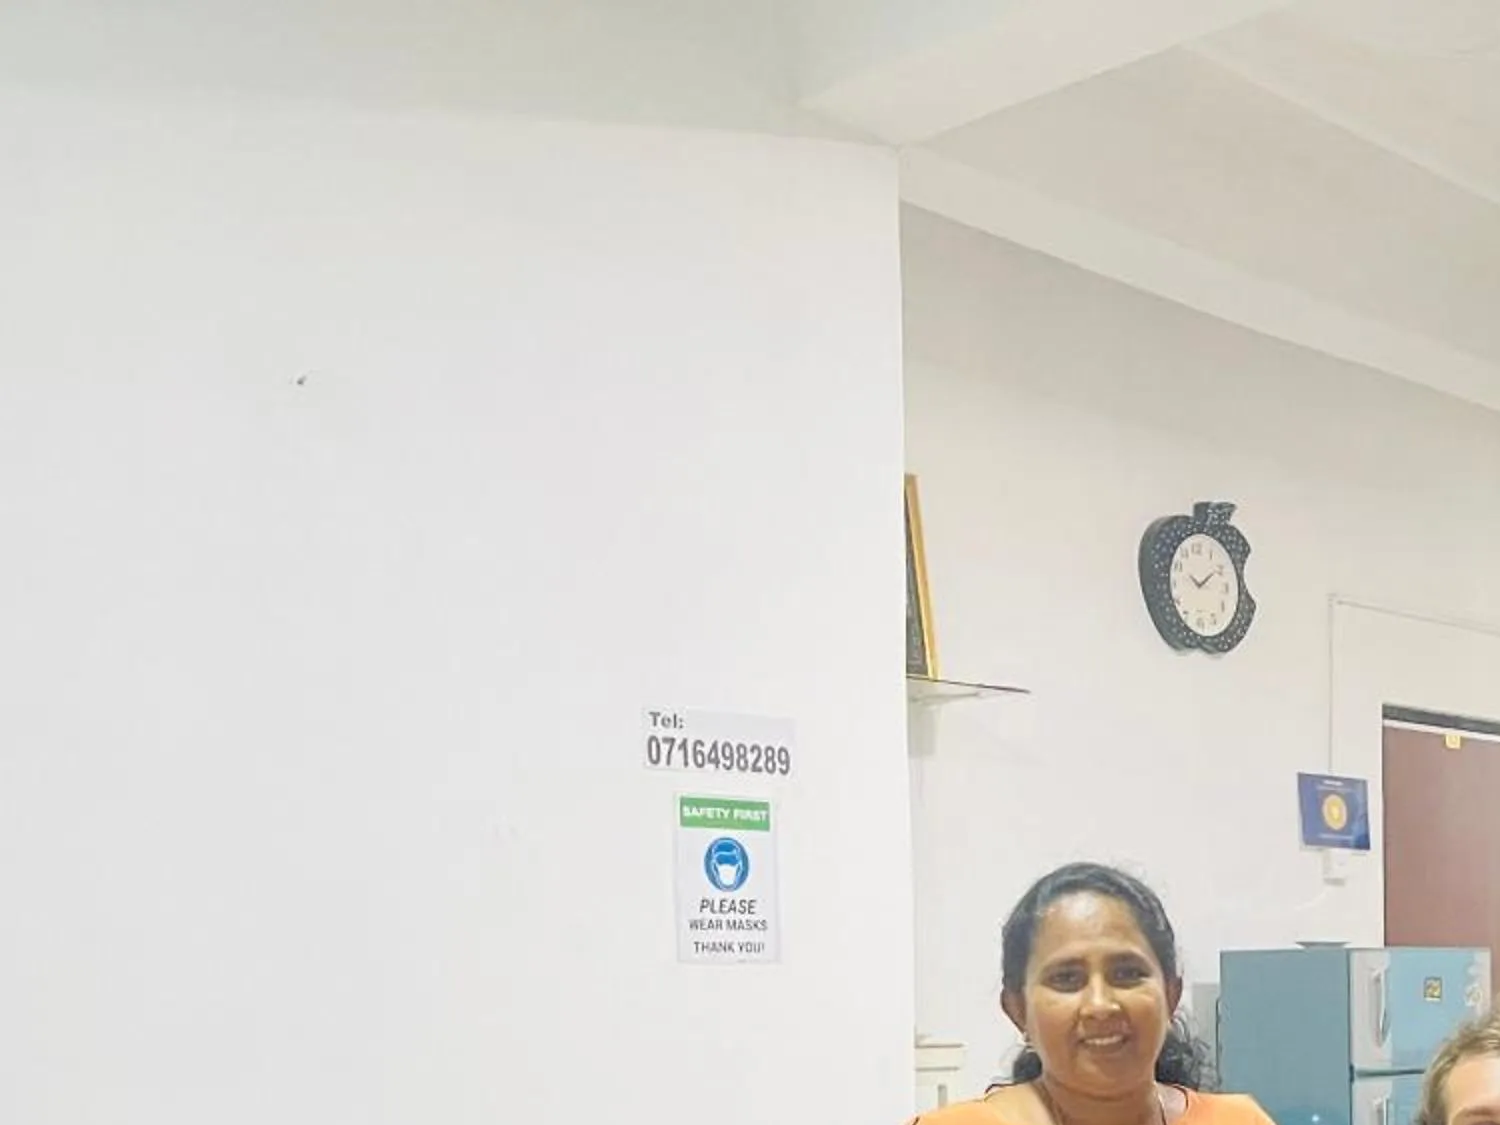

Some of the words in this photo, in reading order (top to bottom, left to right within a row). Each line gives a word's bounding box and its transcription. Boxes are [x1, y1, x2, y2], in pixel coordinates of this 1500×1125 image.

[648, 711, 684, 729] Tel:
[647, 735, 791, 775] 0716498289
[682, 805, 730, 819] SAFETY
[733, 808, 768, 821] FIRST
[699, 898, 757, 915] PLEASE
[688, 919, 723, 931] WEAR
[726, 919, 768, 932] MASKS
[693, 941, 735, 954] THANK
